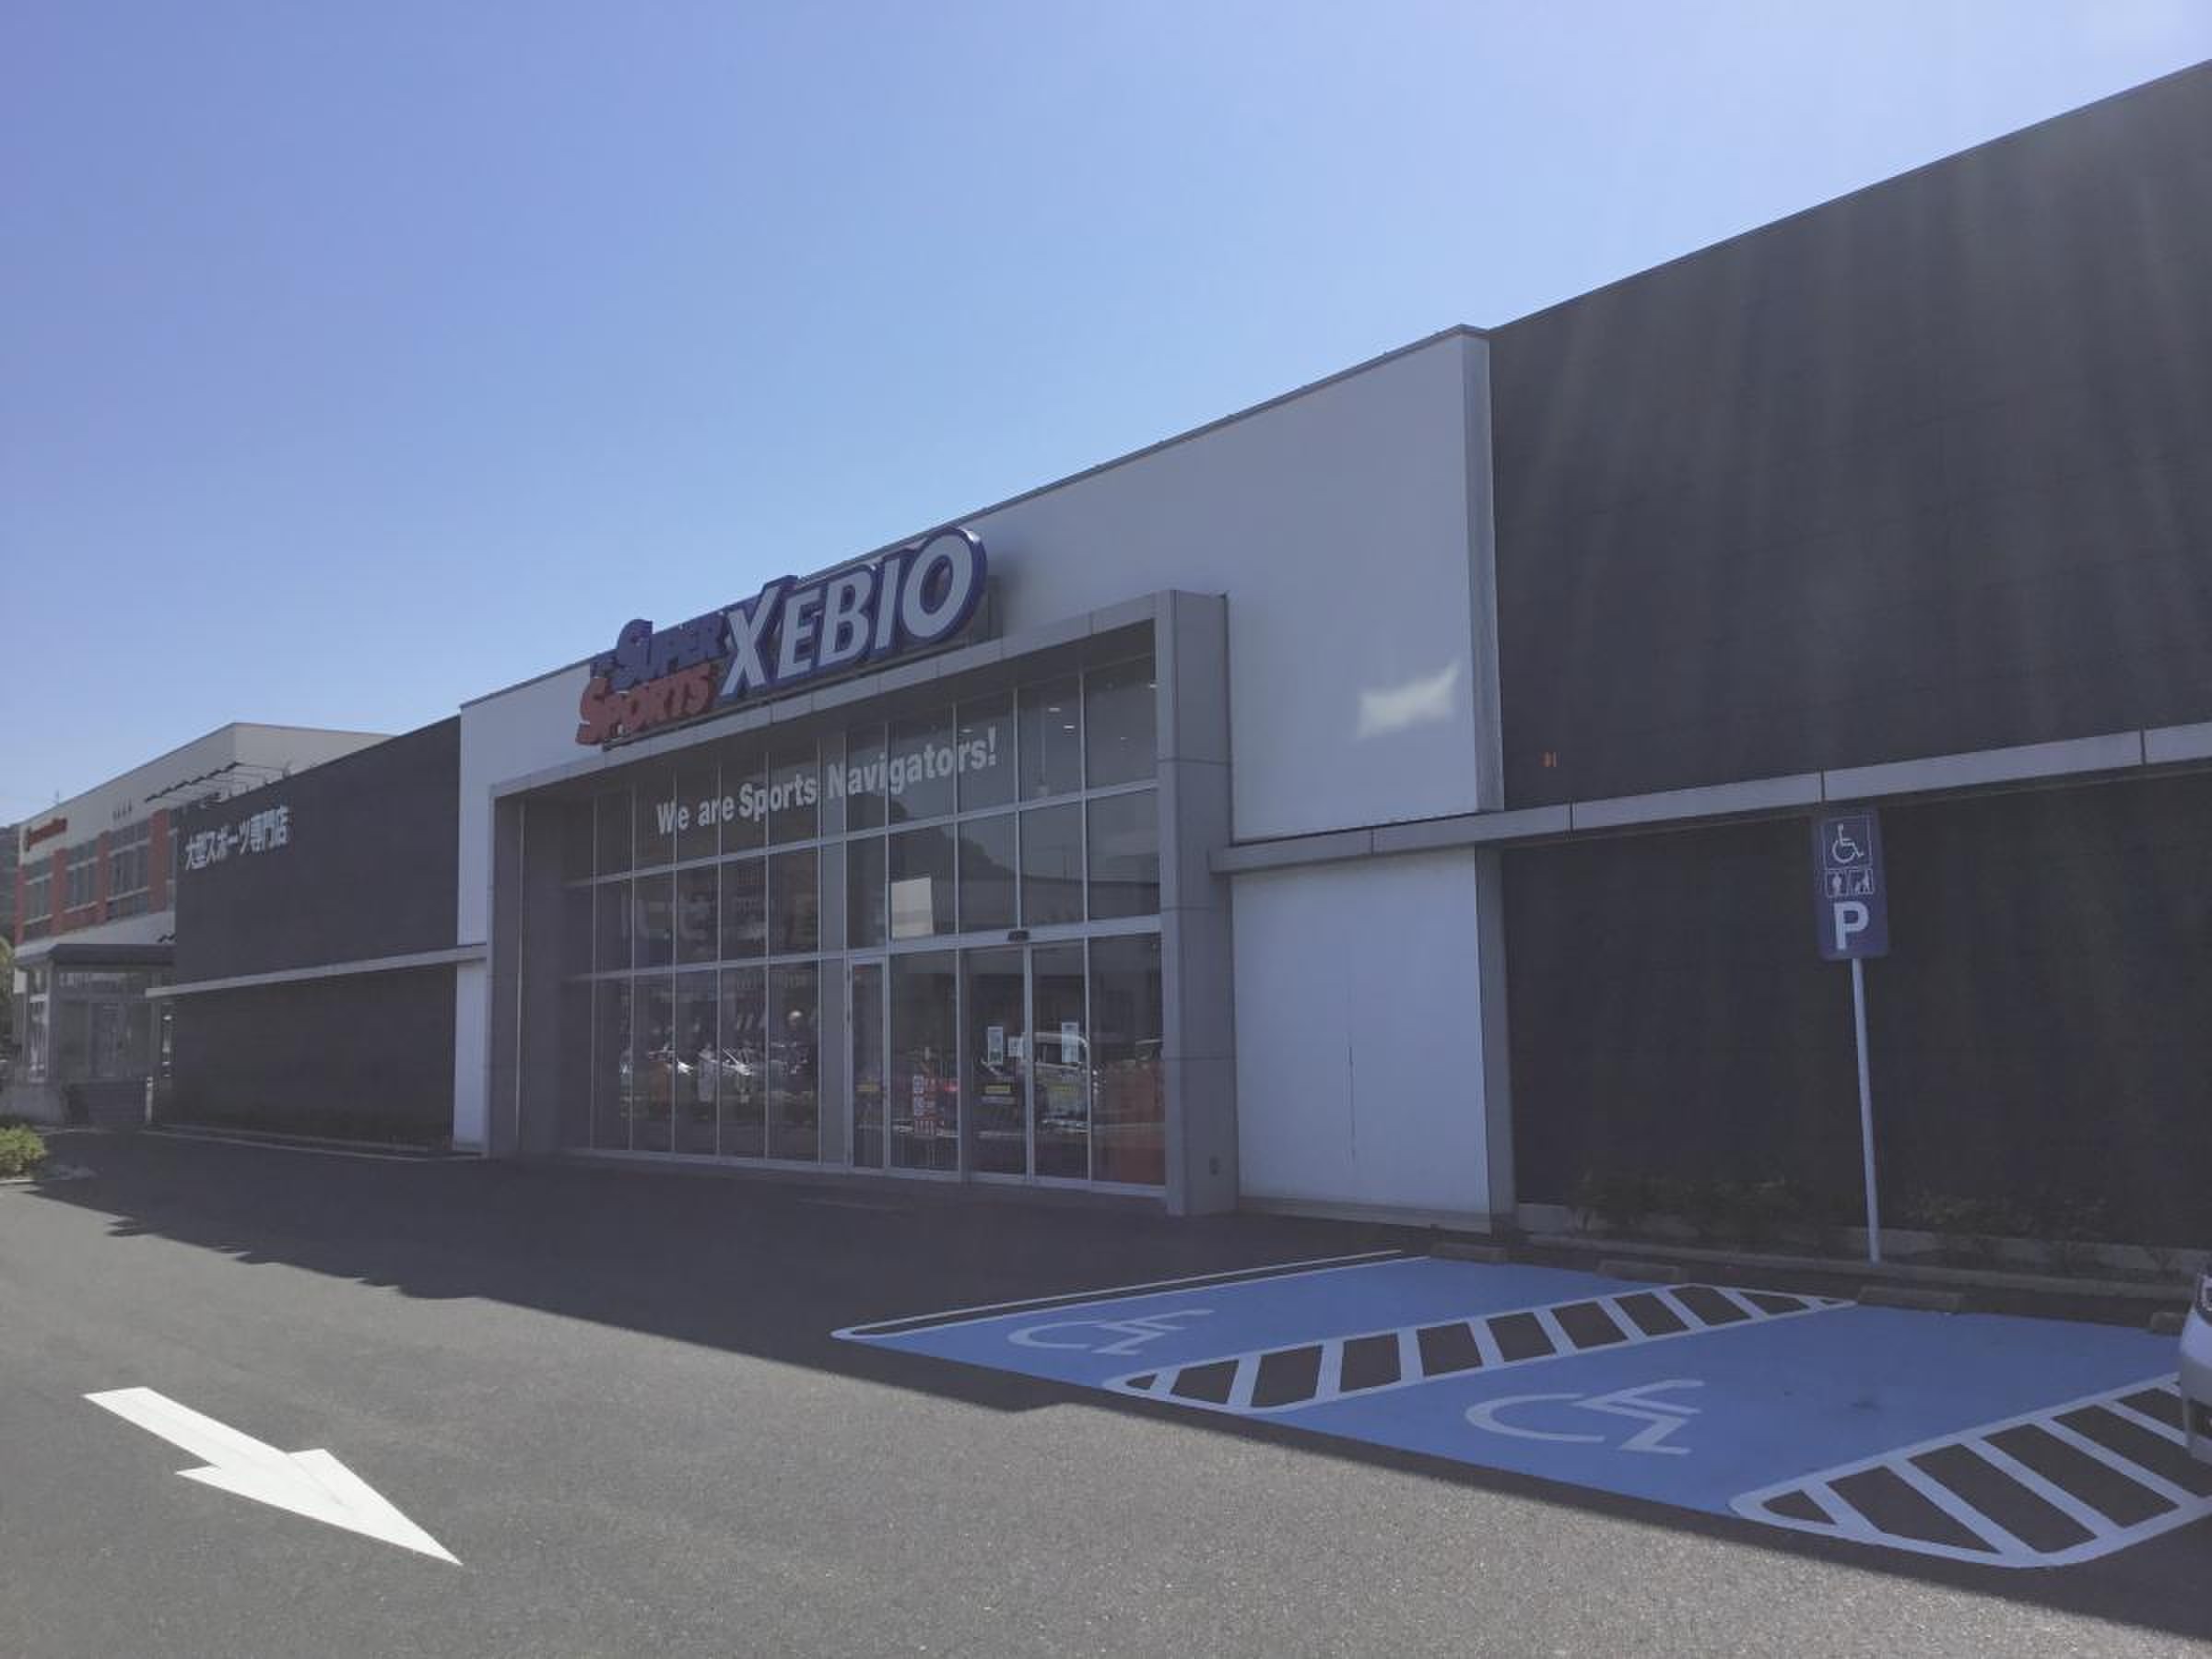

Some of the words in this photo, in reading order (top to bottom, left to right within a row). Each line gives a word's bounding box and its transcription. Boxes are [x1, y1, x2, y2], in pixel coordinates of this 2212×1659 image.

[718, 526, 984, 697] XEBIO
[656, 800, 690, 835] We
[698, 796, 735, 827] are
[738, 773, 818, 822] Sports
[829, 725, 996, 798] Navigators!
[185, 805, 288, 870] 大型スポーツ専門店
[1833, 900, 1870, 951] P
